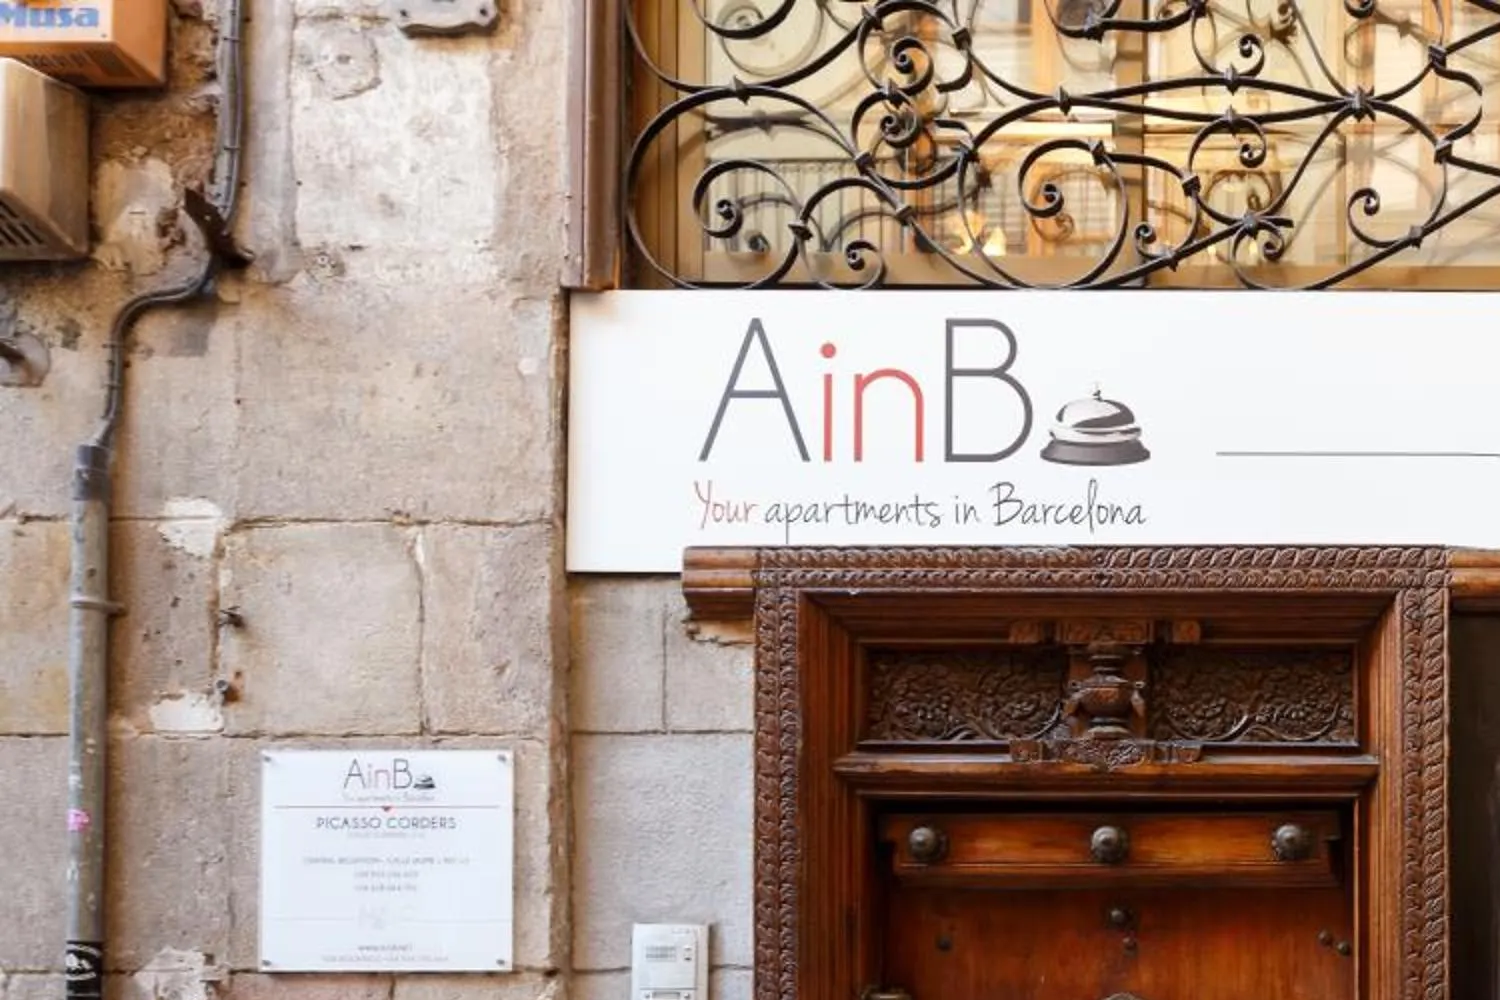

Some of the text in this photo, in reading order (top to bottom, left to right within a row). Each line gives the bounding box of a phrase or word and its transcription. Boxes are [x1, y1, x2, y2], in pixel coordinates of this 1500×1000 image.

[699, 318, 1033, 463] AinB
[694, 479, 1146, 544] Your apartments in Barcelona
[343, 758, 412, 789] AinB
[317, 817, 456, 829] PICASSO CORDERS
